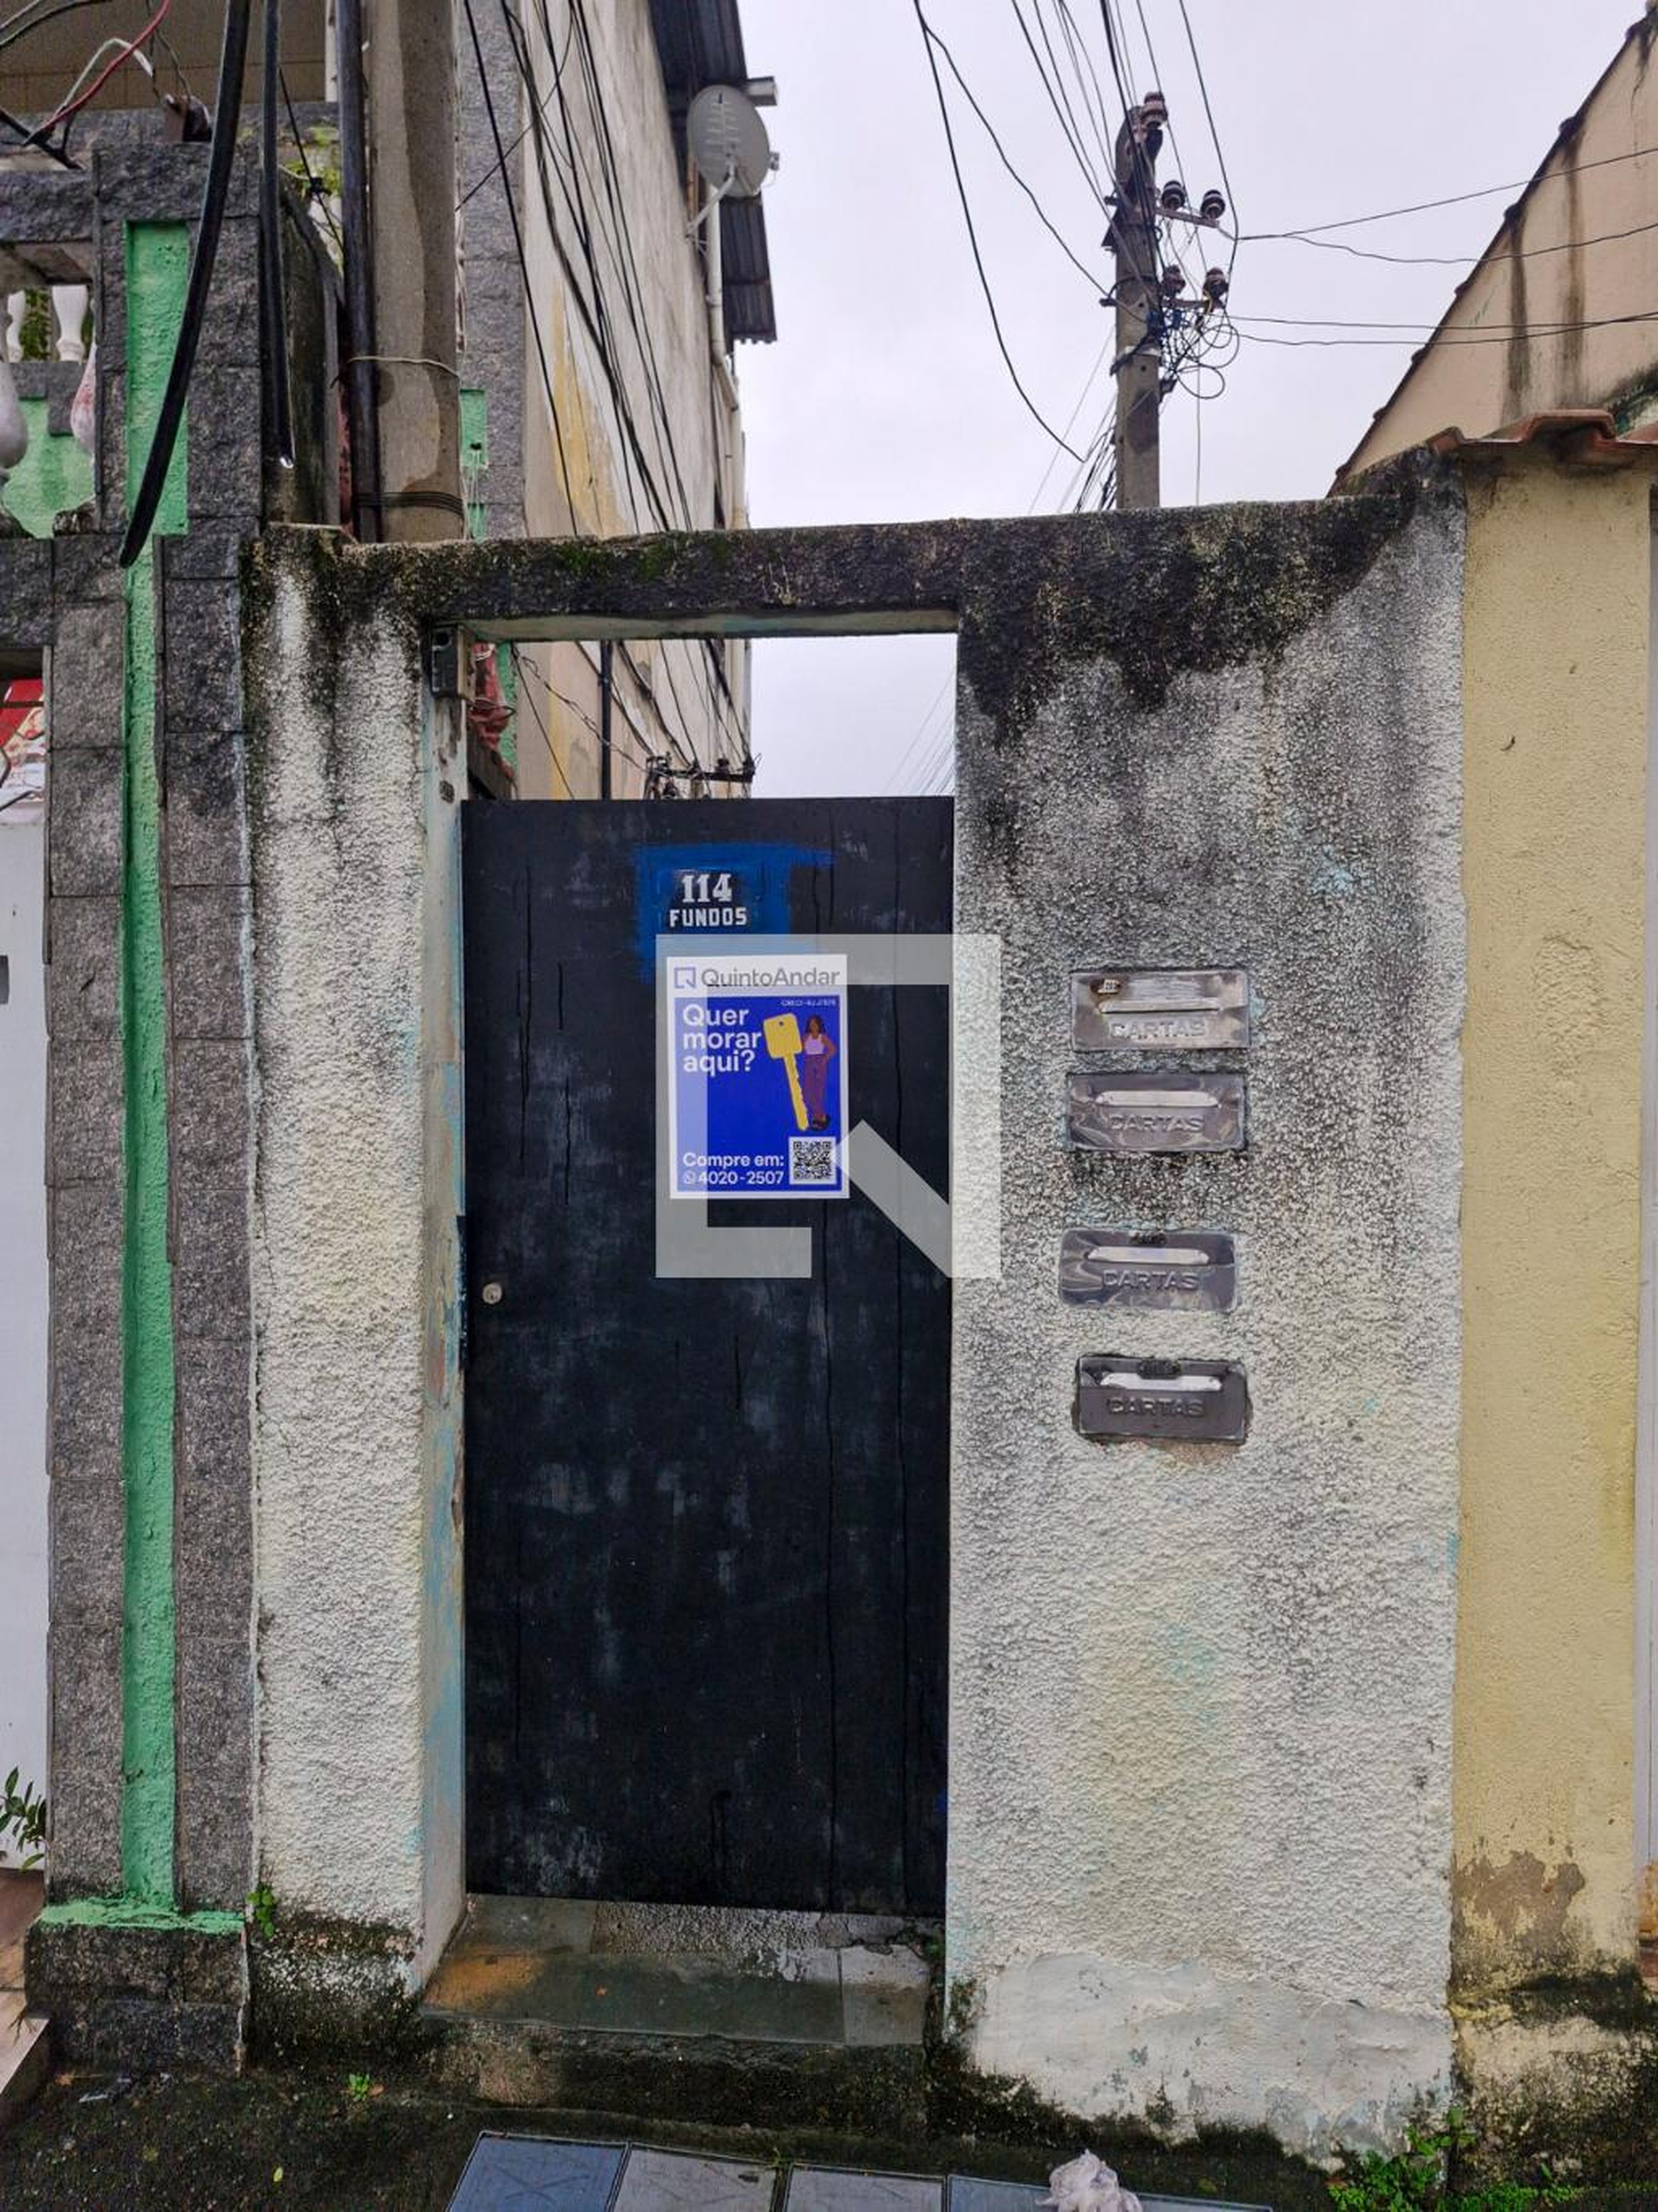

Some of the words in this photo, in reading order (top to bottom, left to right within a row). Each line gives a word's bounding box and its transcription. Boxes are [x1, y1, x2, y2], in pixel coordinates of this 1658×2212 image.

[681, 873, 732, 903] 114
[670, 907, 747, 927] FUNDOS
[701, 967, 840, 987] QuintoAndar
[683, 1004, 749, 1027] Quer
[683, 1031, 762, 1049] morar
[1108, 1021, 1206, 1039] CARTAS
[683, 1049, 756, 1077] aqui?
[1109, 1114, 1205, 1133] CARTAS
[683, 1152, 750, 1169] Compre
[753, 1154, 785, 1167] em:
[698, 1170, 784, 1185] 4020-2507
[1103, 1270, 1200, 1290] CARTAS
[1107, 1396, 1206, 1418] CARTAS
